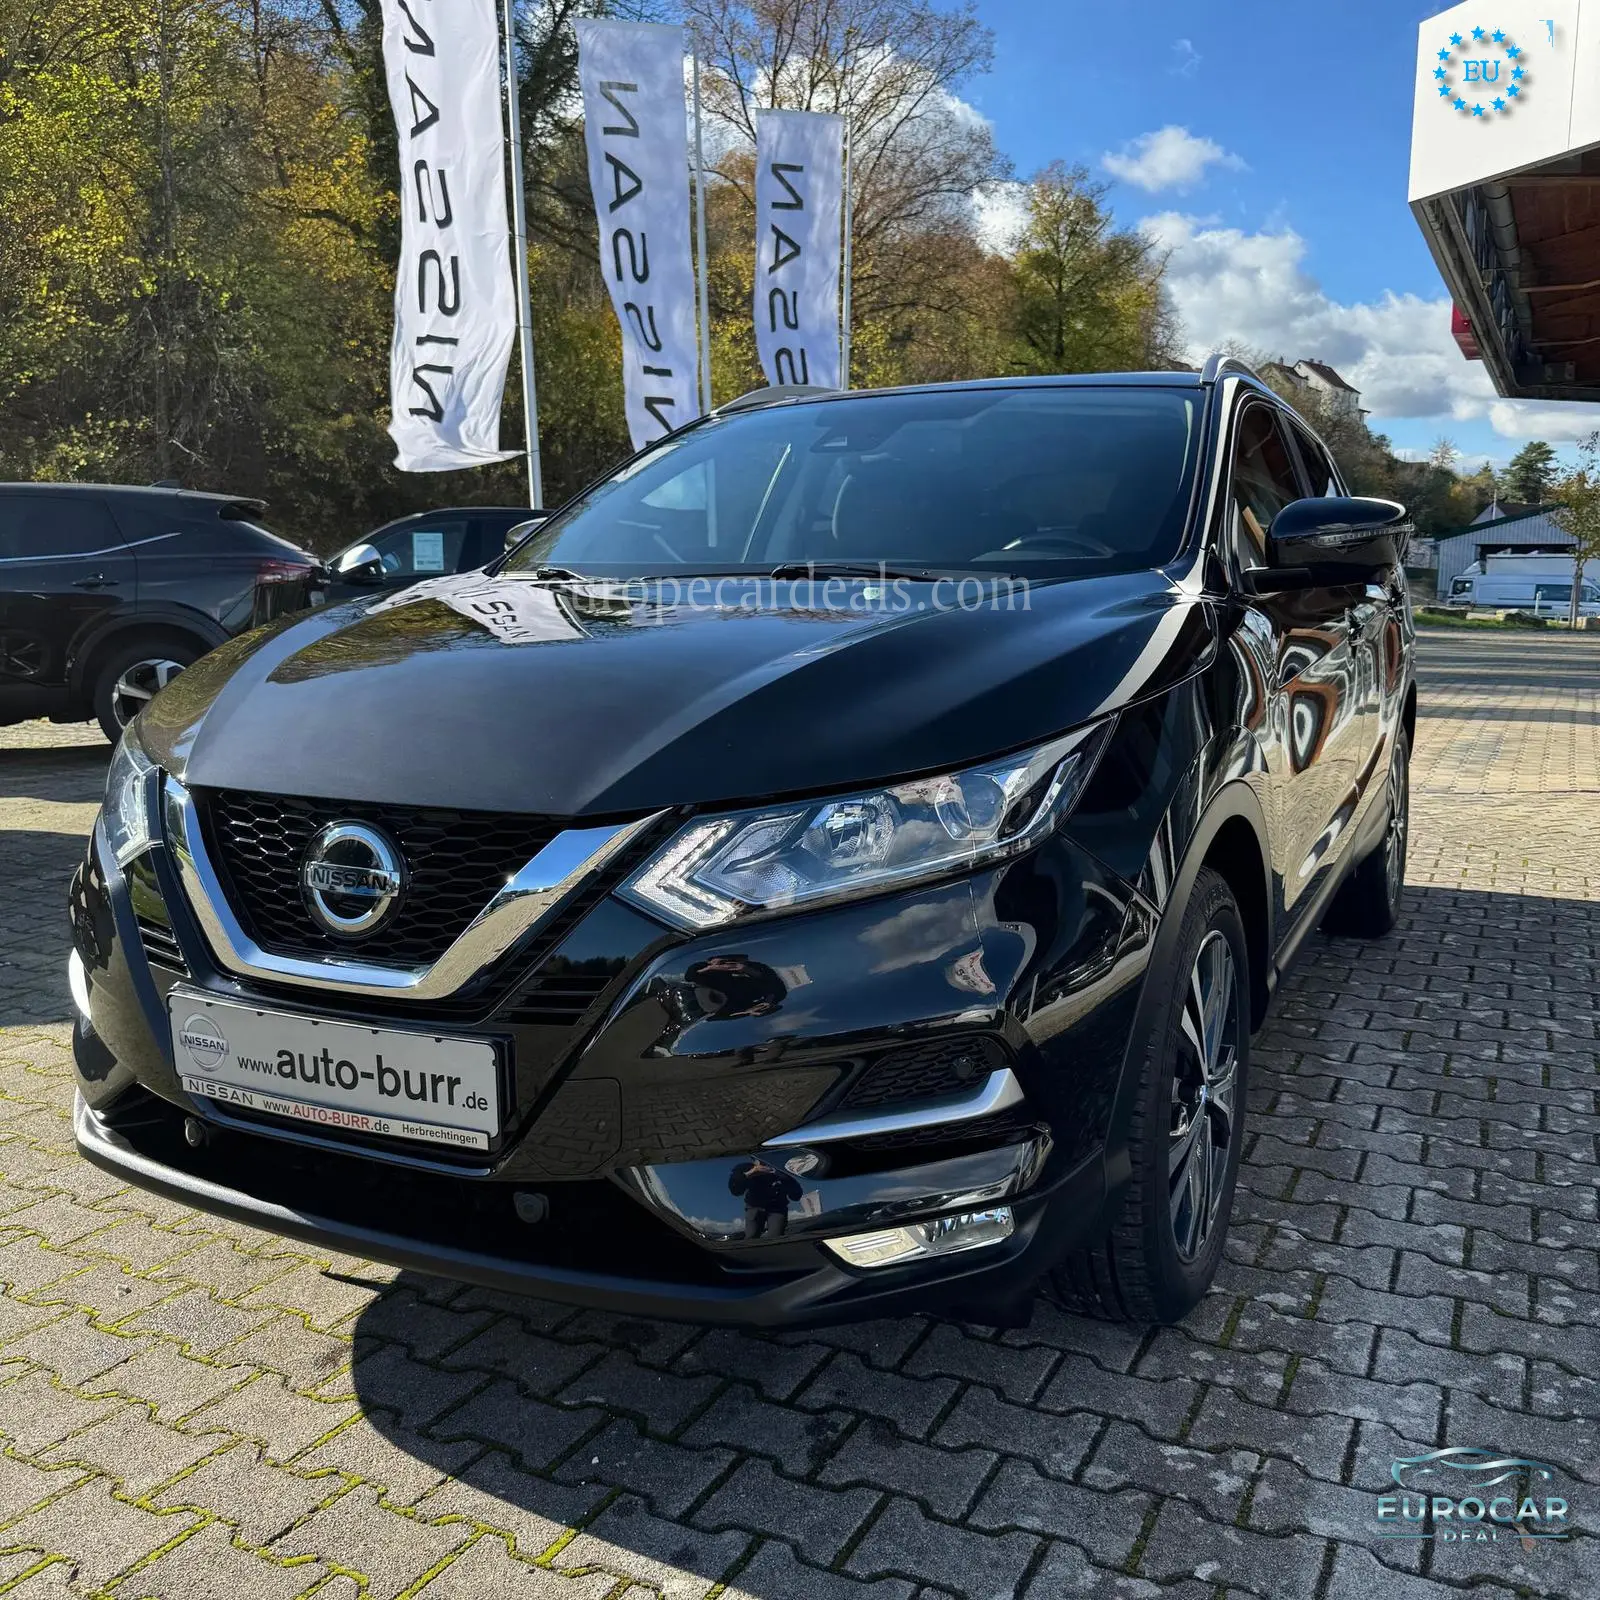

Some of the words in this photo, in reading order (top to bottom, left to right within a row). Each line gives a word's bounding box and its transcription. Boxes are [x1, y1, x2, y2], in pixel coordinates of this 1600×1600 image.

[312, 867, 389, 892] NISSAN
[184, 1034, 225, 1052] NISSAN
[237, 1048, 489, 1111] www.auto-burr.de
[189, 1079, 254, 1106] NISSAN
[263, 1099, 391, 1133] www.AUTO-BURR.de
[402, 1123, 478, 1145] Herbrechtingen
